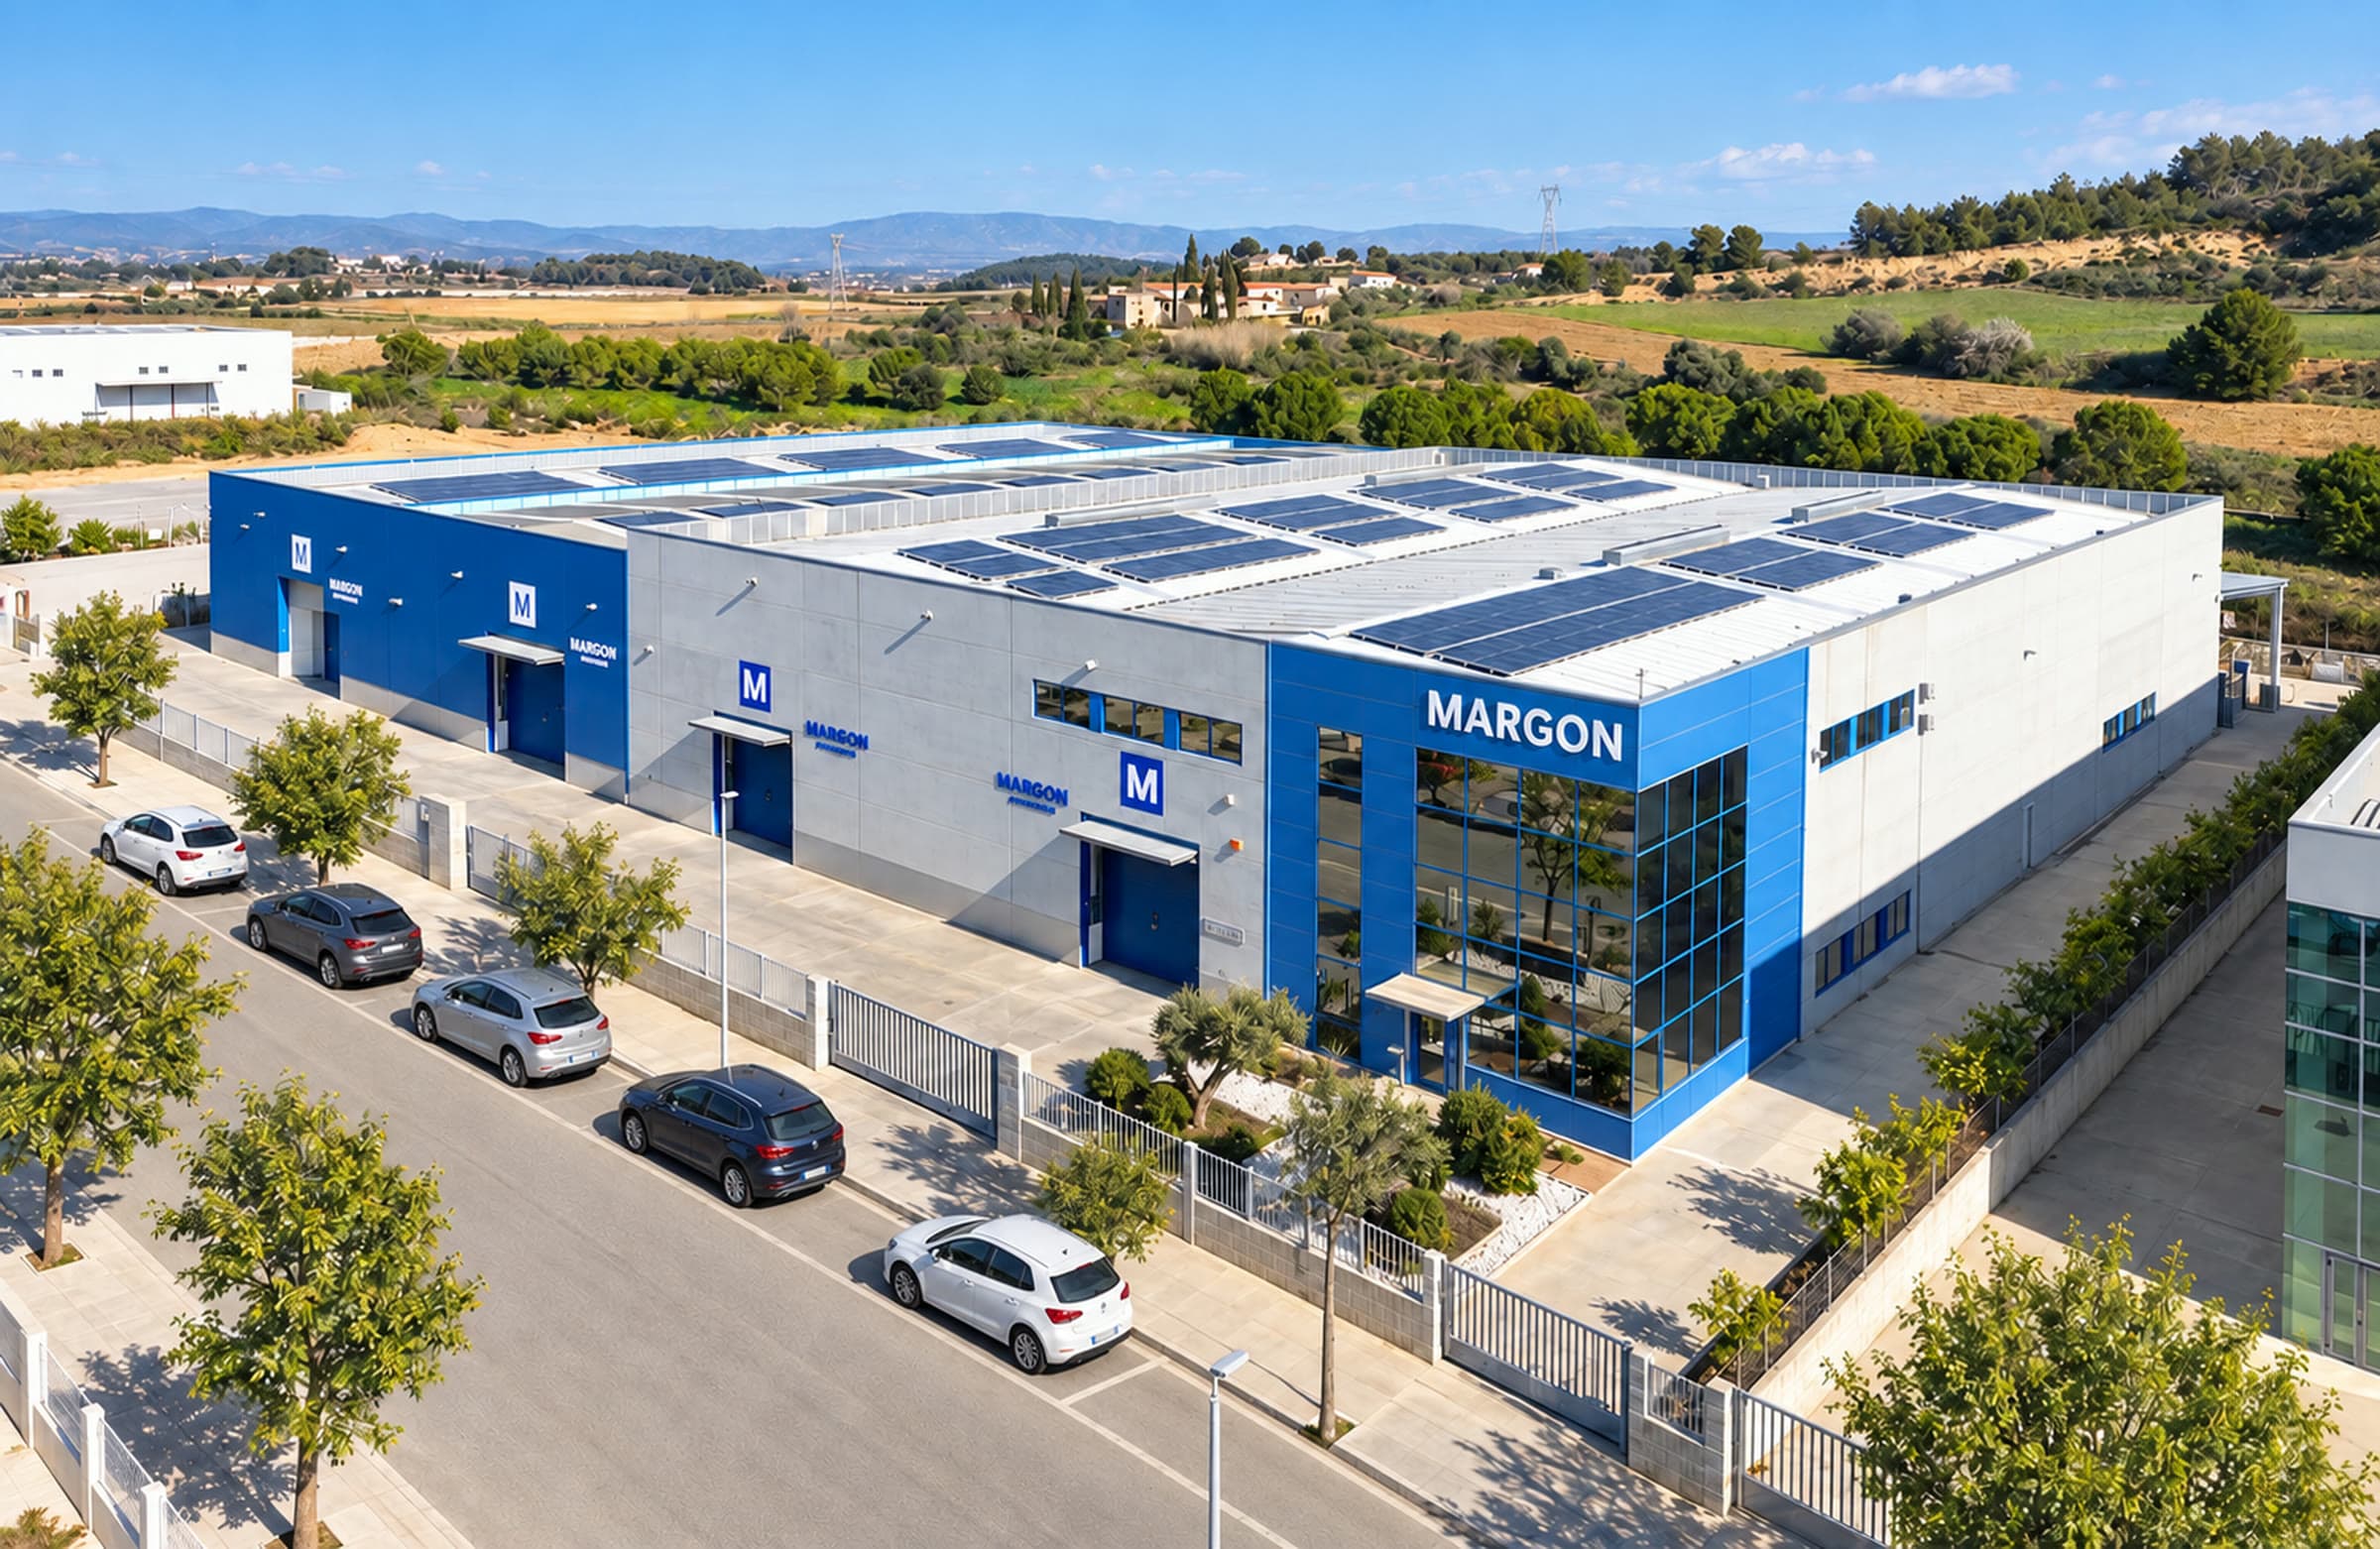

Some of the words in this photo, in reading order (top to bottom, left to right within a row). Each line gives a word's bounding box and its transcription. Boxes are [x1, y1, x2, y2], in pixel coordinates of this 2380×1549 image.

[295, 541, 307, 565] M
[515, 591, 531, 619] M
[569, 637, 617, 660] MARGON
[743, 667, 768, 703] M
[805, 720, 870, 751] MARGON
[1428, 689, 1623, 763] MARGON
[996, 771, 1069, 806] MARGON
[1127, 763, 1158, 804] M
